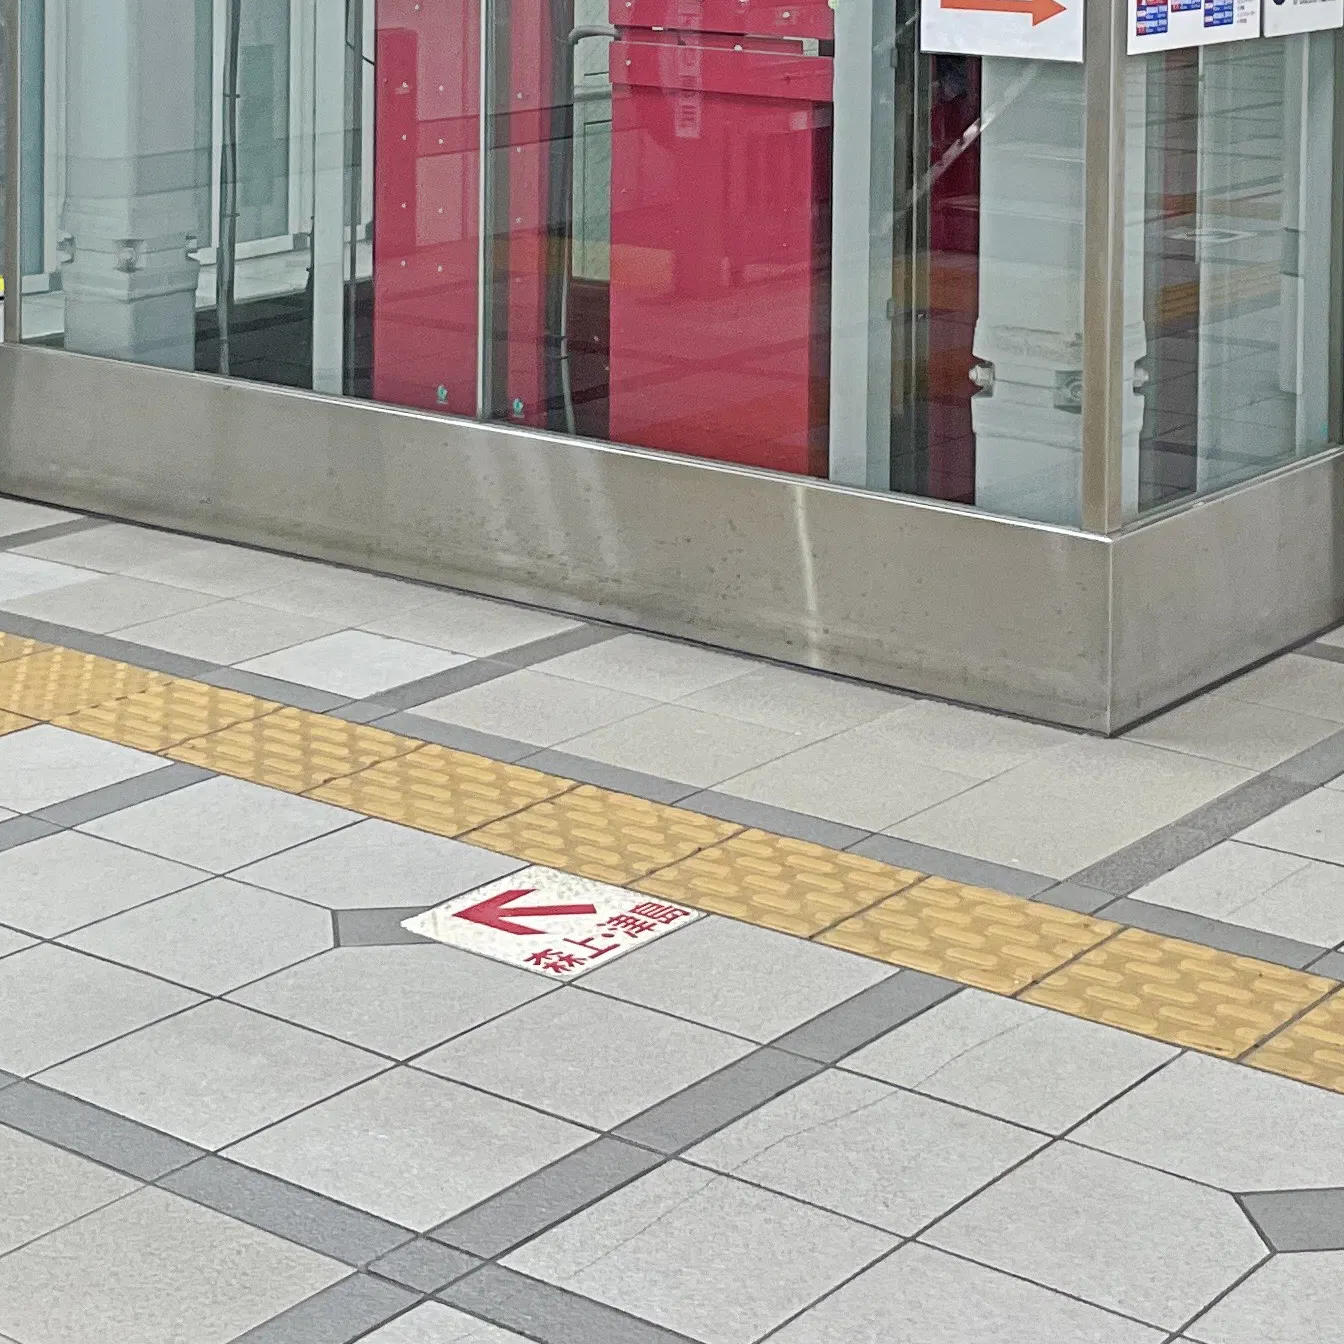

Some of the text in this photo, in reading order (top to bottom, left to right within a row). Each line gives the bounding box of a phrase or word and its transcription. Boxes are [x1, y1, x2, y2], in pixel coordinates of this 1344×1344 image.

[523, 901, 691, 974] 森上・津島
